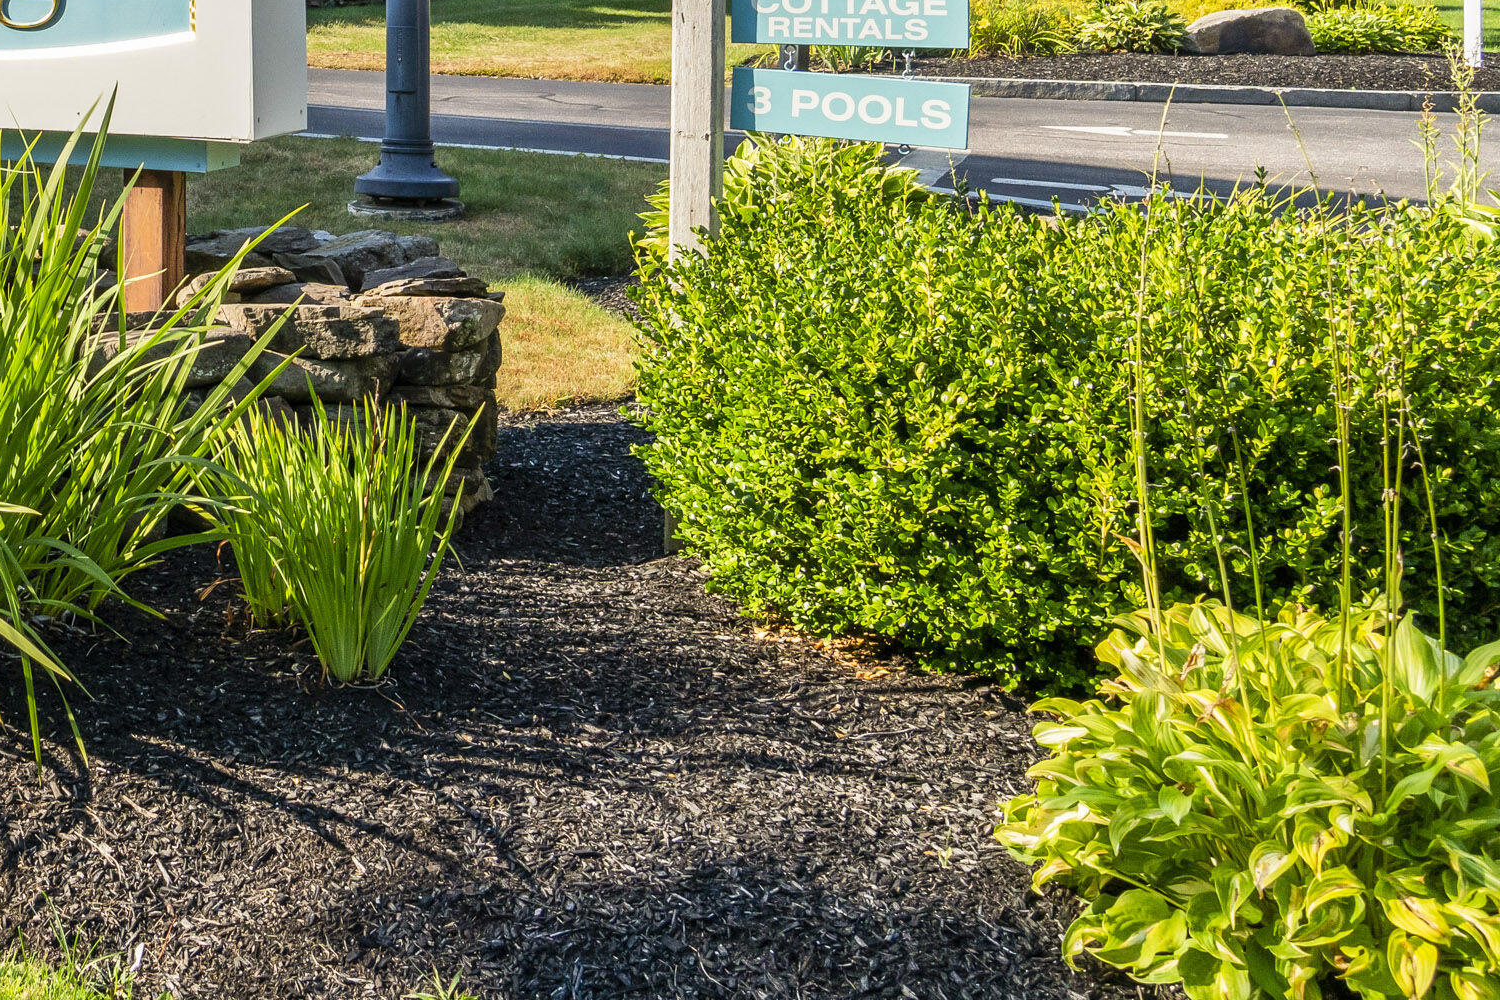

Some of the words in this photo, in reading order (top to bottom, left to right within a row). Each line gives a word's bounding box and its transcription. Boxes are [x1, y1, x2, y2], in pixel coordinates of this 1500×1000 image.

[767, 16, 929, 41] RENTALS
[747, 86, 772, 115] 3
[791, 89, 952, 130] POOLS
